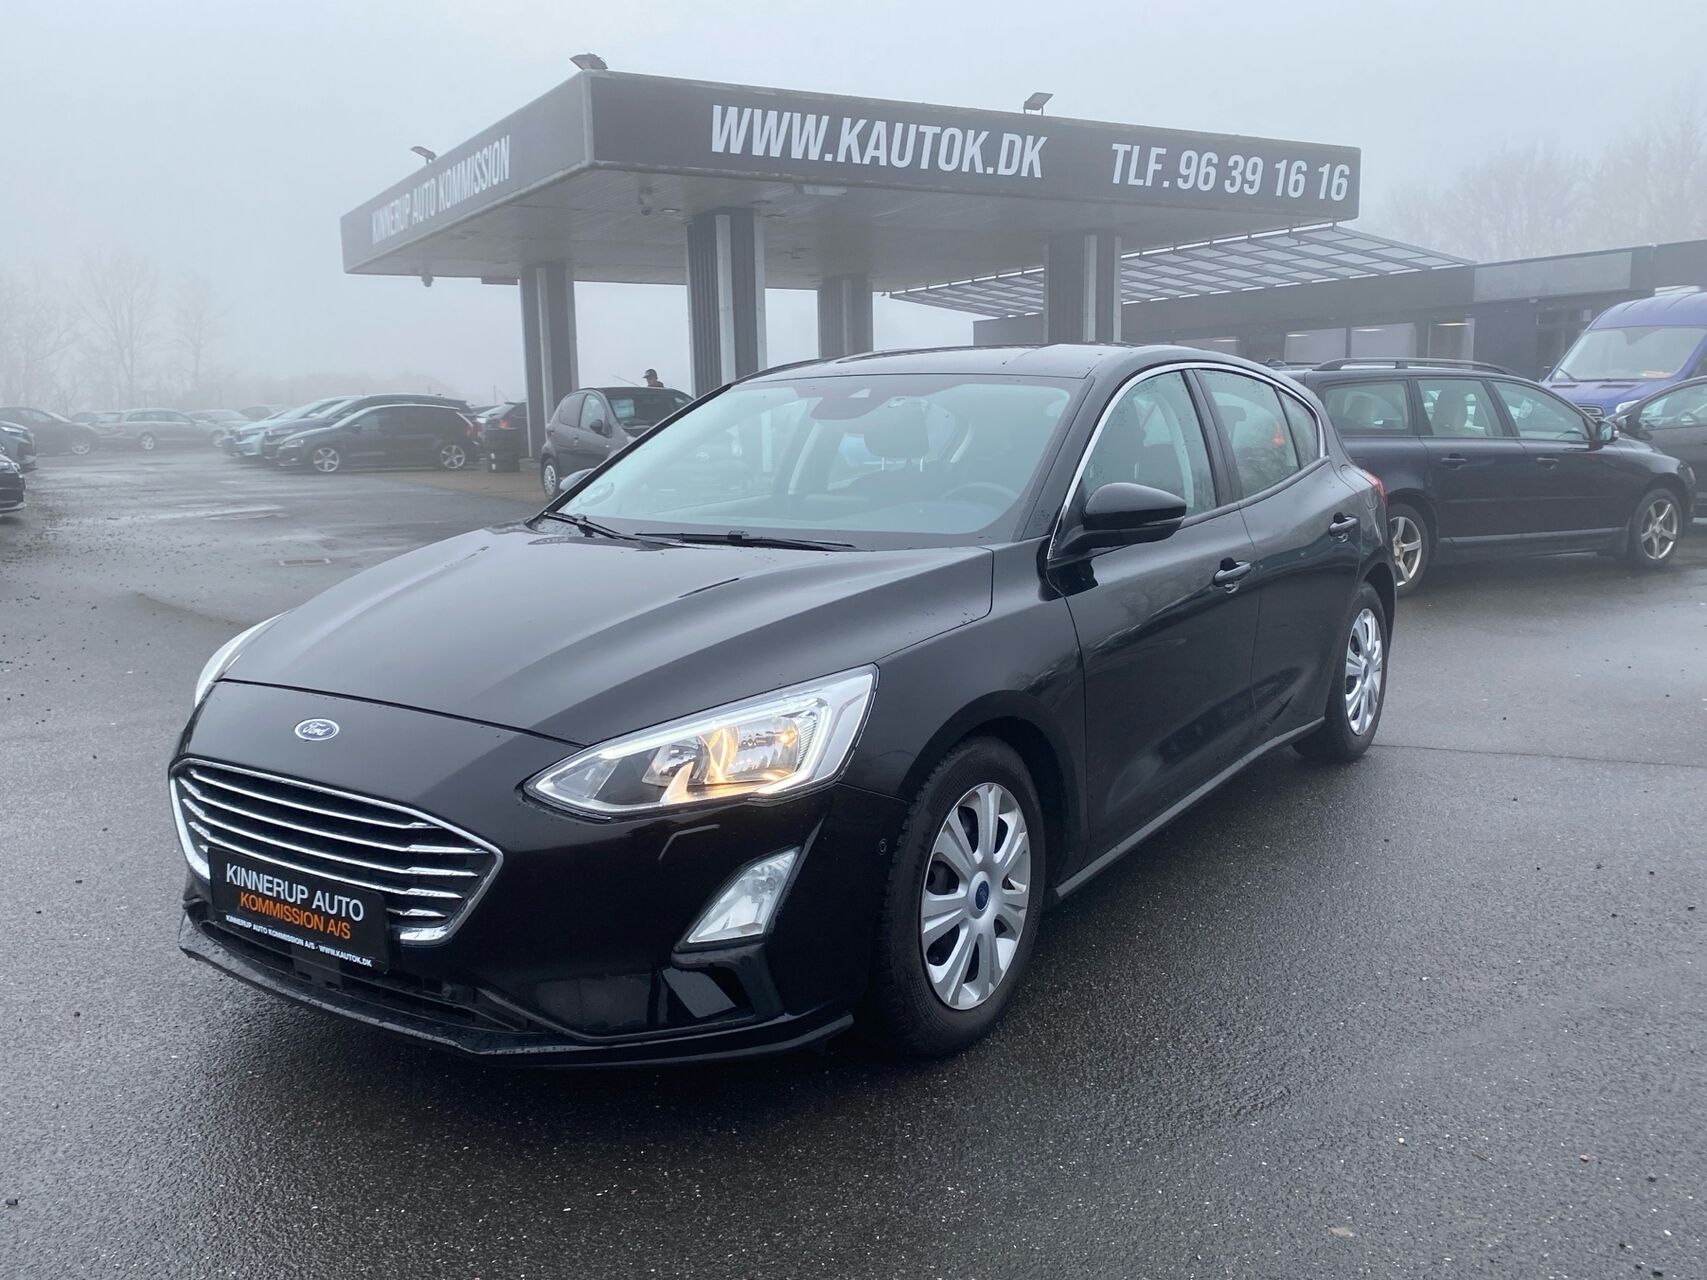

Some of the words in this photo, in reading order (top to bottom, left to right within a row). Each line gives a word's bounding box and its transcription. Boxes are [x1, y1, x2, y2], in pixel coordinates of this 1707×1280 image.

[711, 104, 1048, 178] WWW.KAUTOK.DK
[412, 177, 437, 225] AUTO
[439, 134, 510, 213] KOMMISSION
[1111, 143, 1170, 188] TLF.
[1177, 150, 1219, 191] 96
[1224, 154, 1264, 195] 39
[1275, 159, 1308, 199] 16
[1318, 163, 1351, 201] 16
[302, 721, 330, 737] Ford
[226, 863, 309, 905] KINNERUP
[312, 890, 365, 922] AUTO
[240, 892, 324, 932] KOMMISSION
[327, 920, 352, 940] A/S
[252, 923, 268, 935] AUTO
